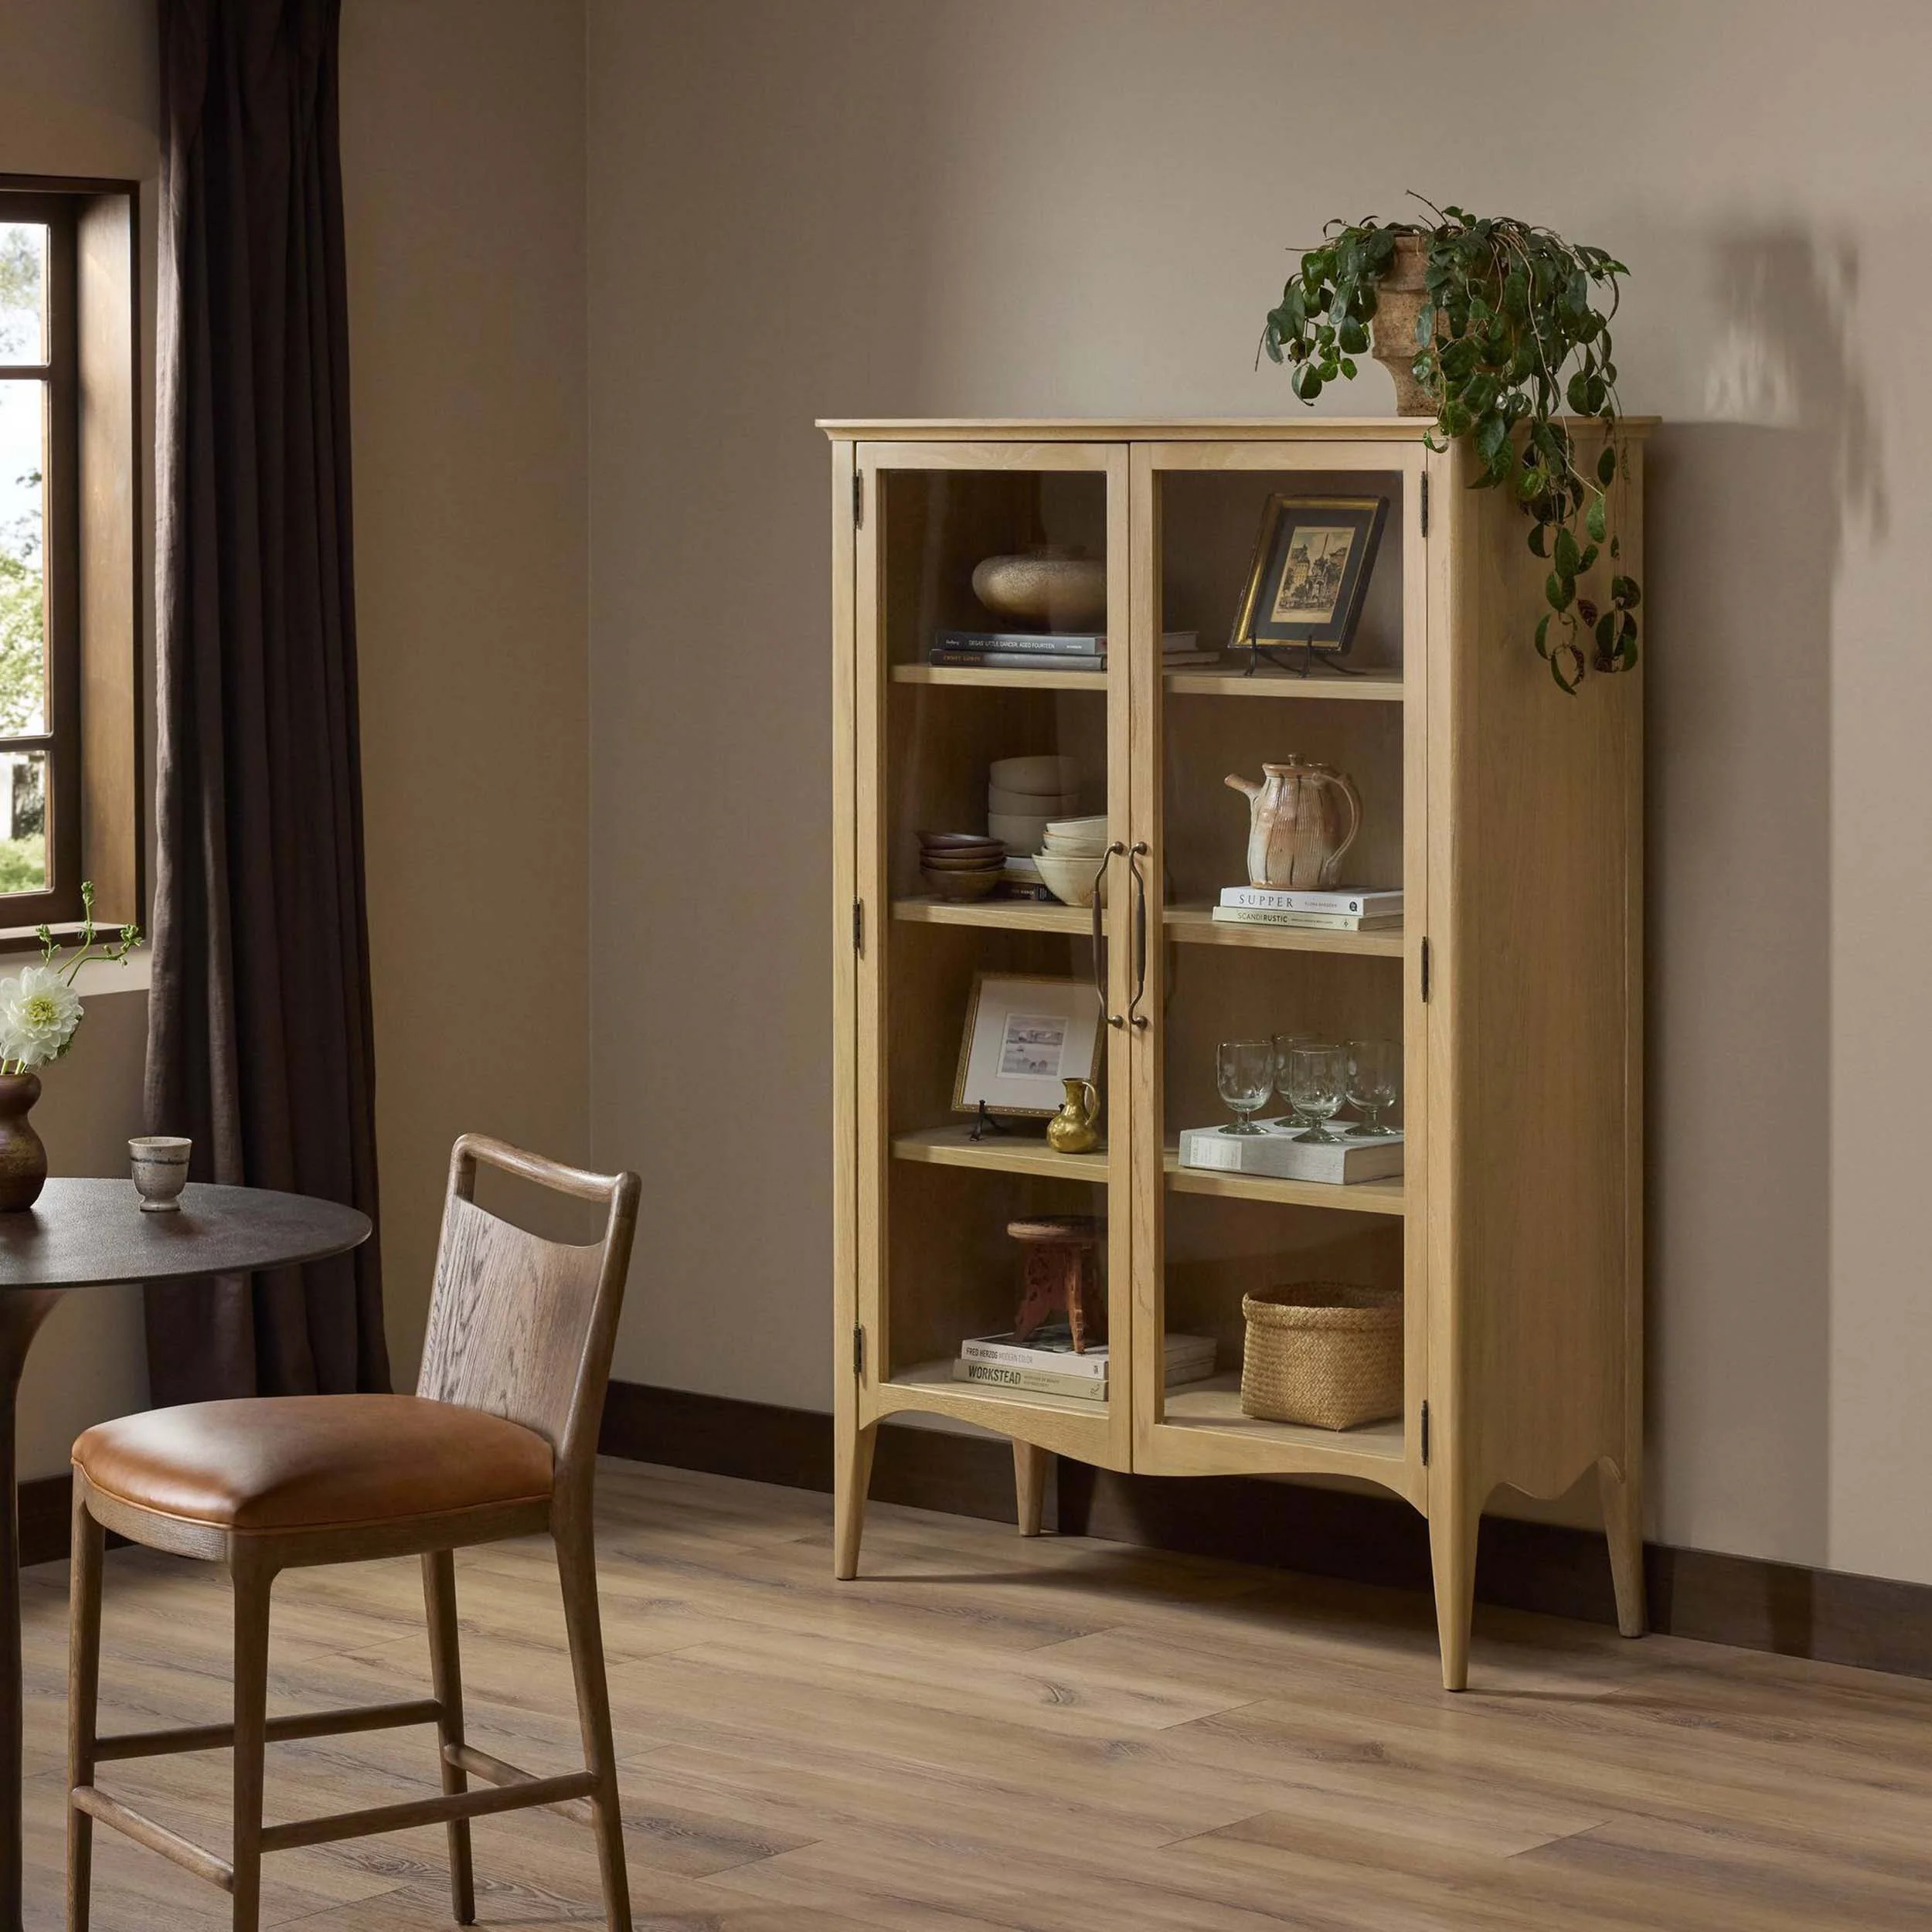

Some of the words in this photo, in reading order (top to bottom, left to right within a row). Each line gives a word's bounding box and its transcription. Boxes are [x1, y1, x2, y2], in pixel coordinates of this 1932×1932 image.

[1239, 894, 1294, 908] SUPPER
[1237, 913, 1287, 923] SCANDIRUSTIC
[966, 1347, 979, 1356] FRED
[979, 1349, 998, 1359] HERZOG
[968, 1365, 1021, 1385] WORKSTEAD
